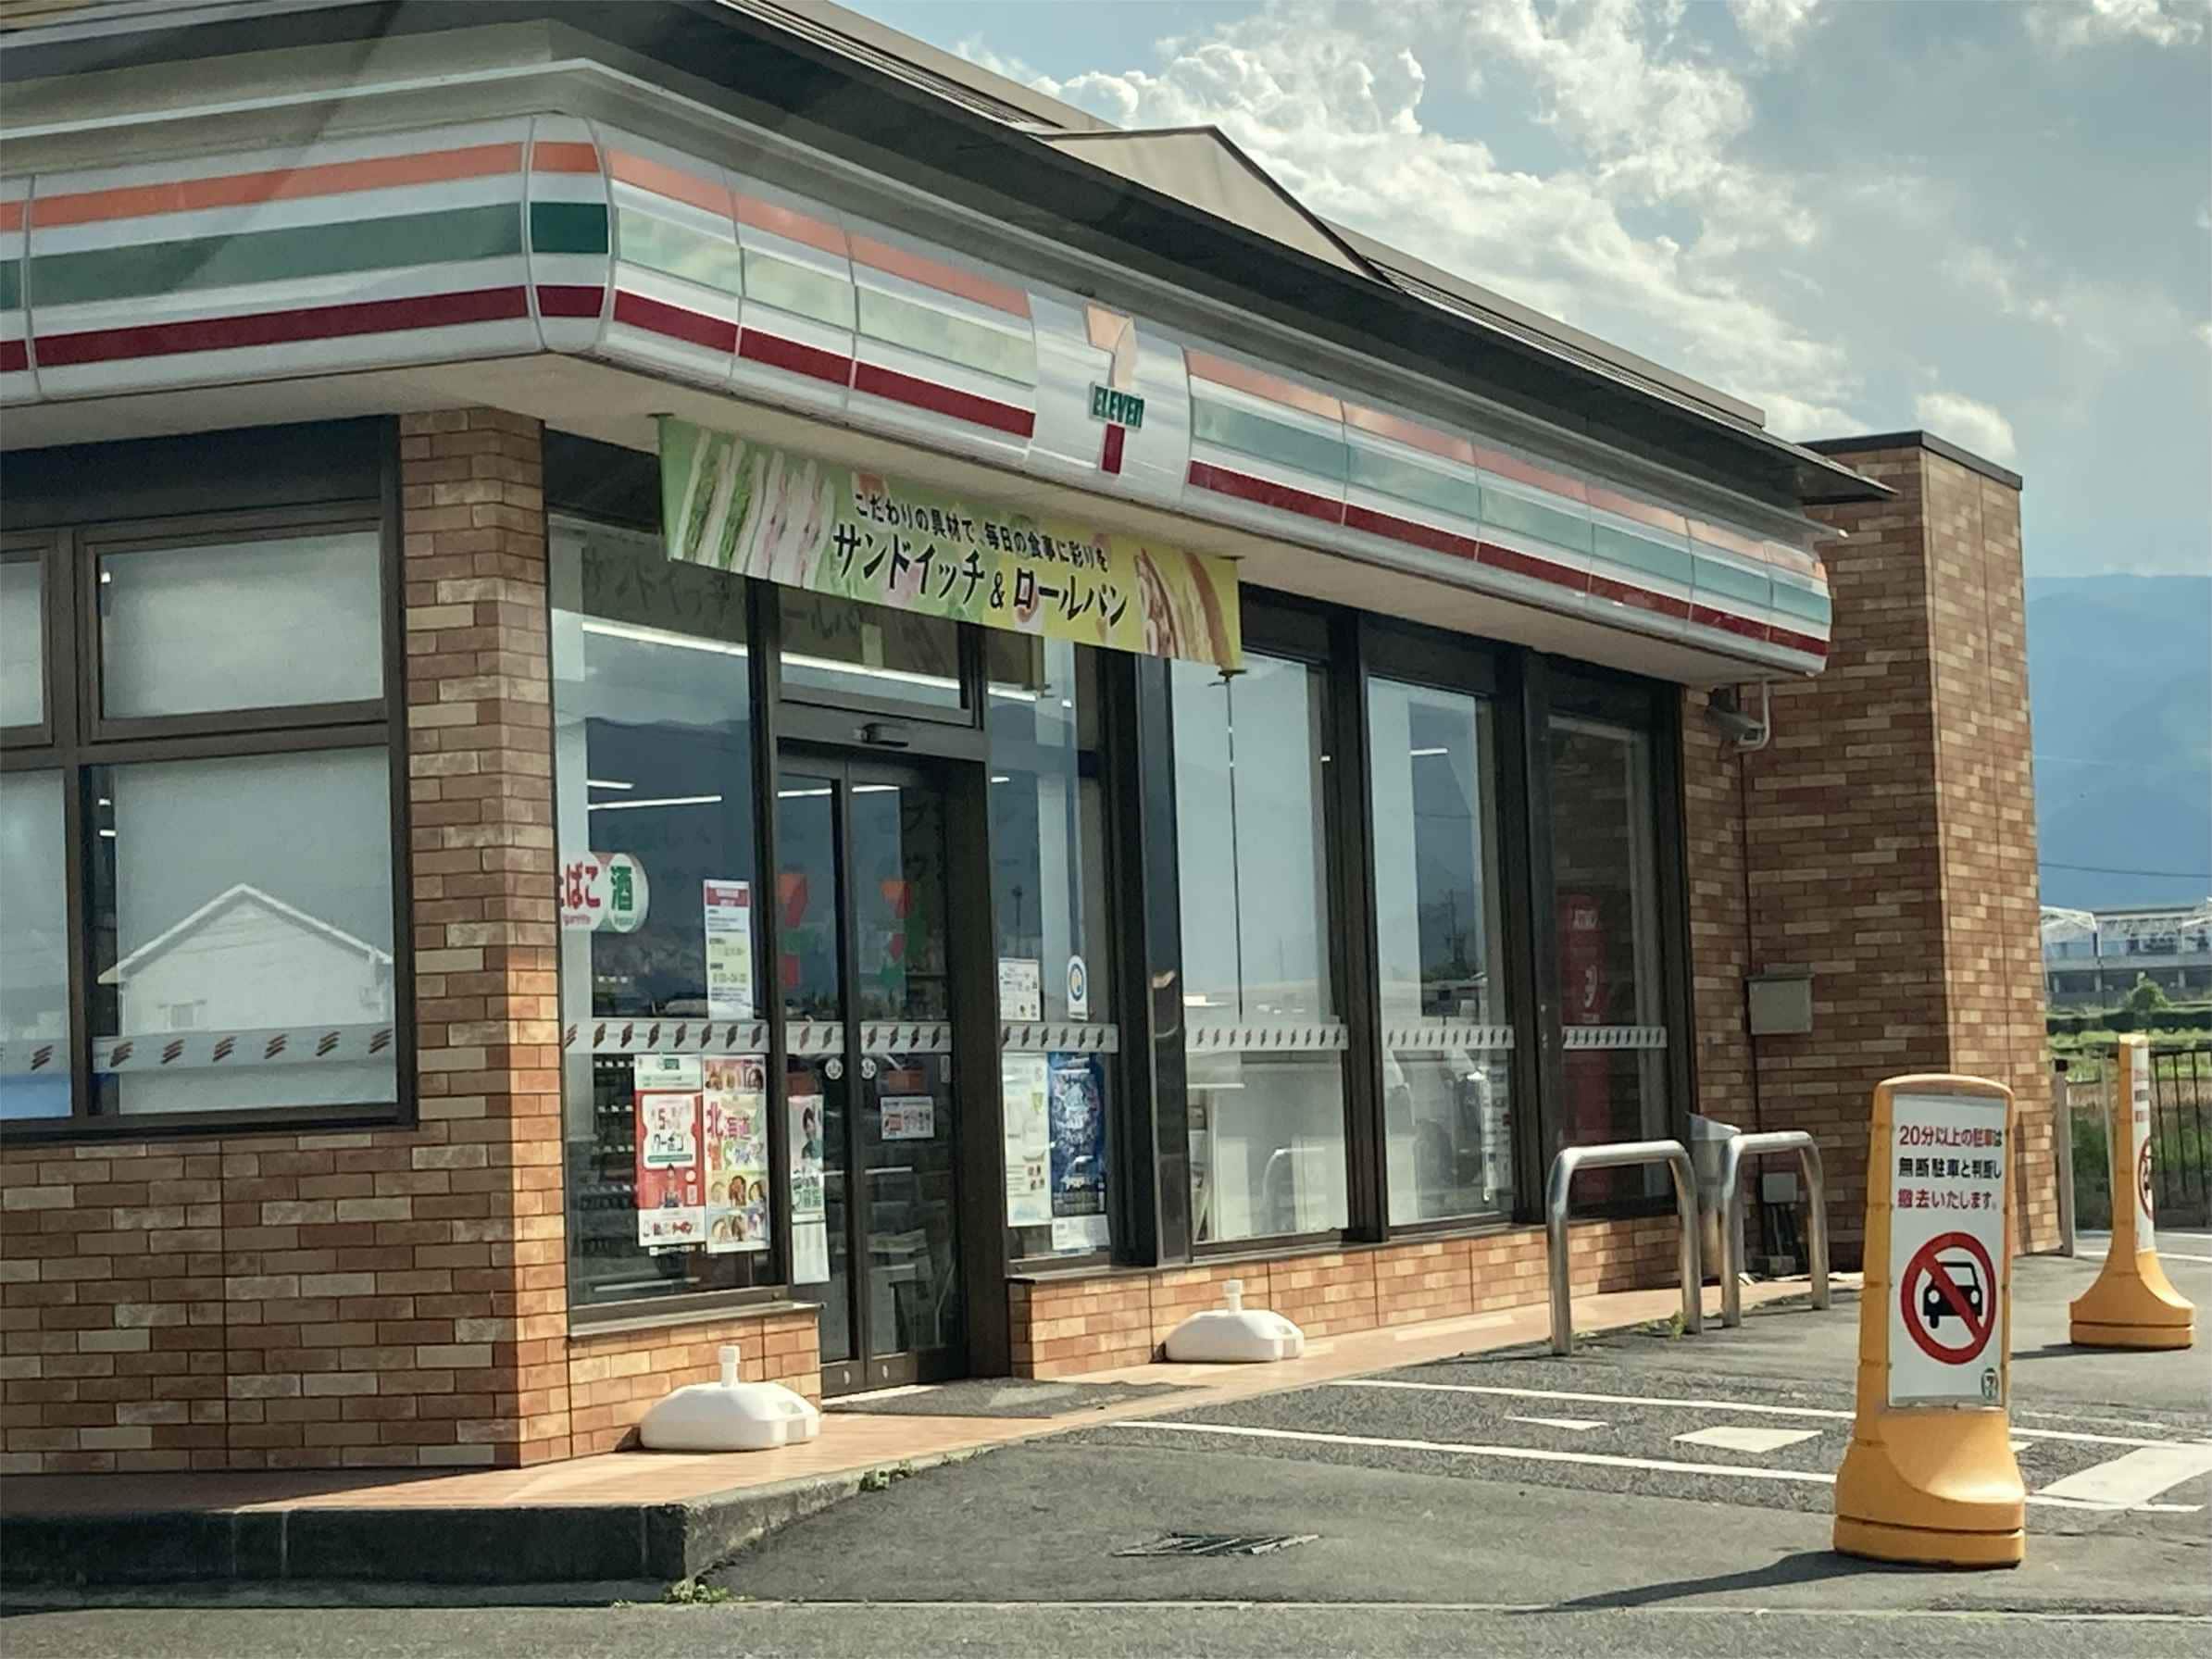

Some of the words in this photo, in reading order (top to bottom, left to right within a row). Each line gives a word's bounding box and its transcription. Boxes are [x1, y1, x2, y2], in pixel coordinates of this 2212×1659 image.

[558, 861, 602, 910] ばこ
[610, 866, 633, 912] 酒
[1899, 1125, 2002, 1148] 20分以上の駐車は
[1898, 1156, 2002, 1179] 無断駐車と判断し
[1897, 1188, 1997, 1210] 撤去いたします。
